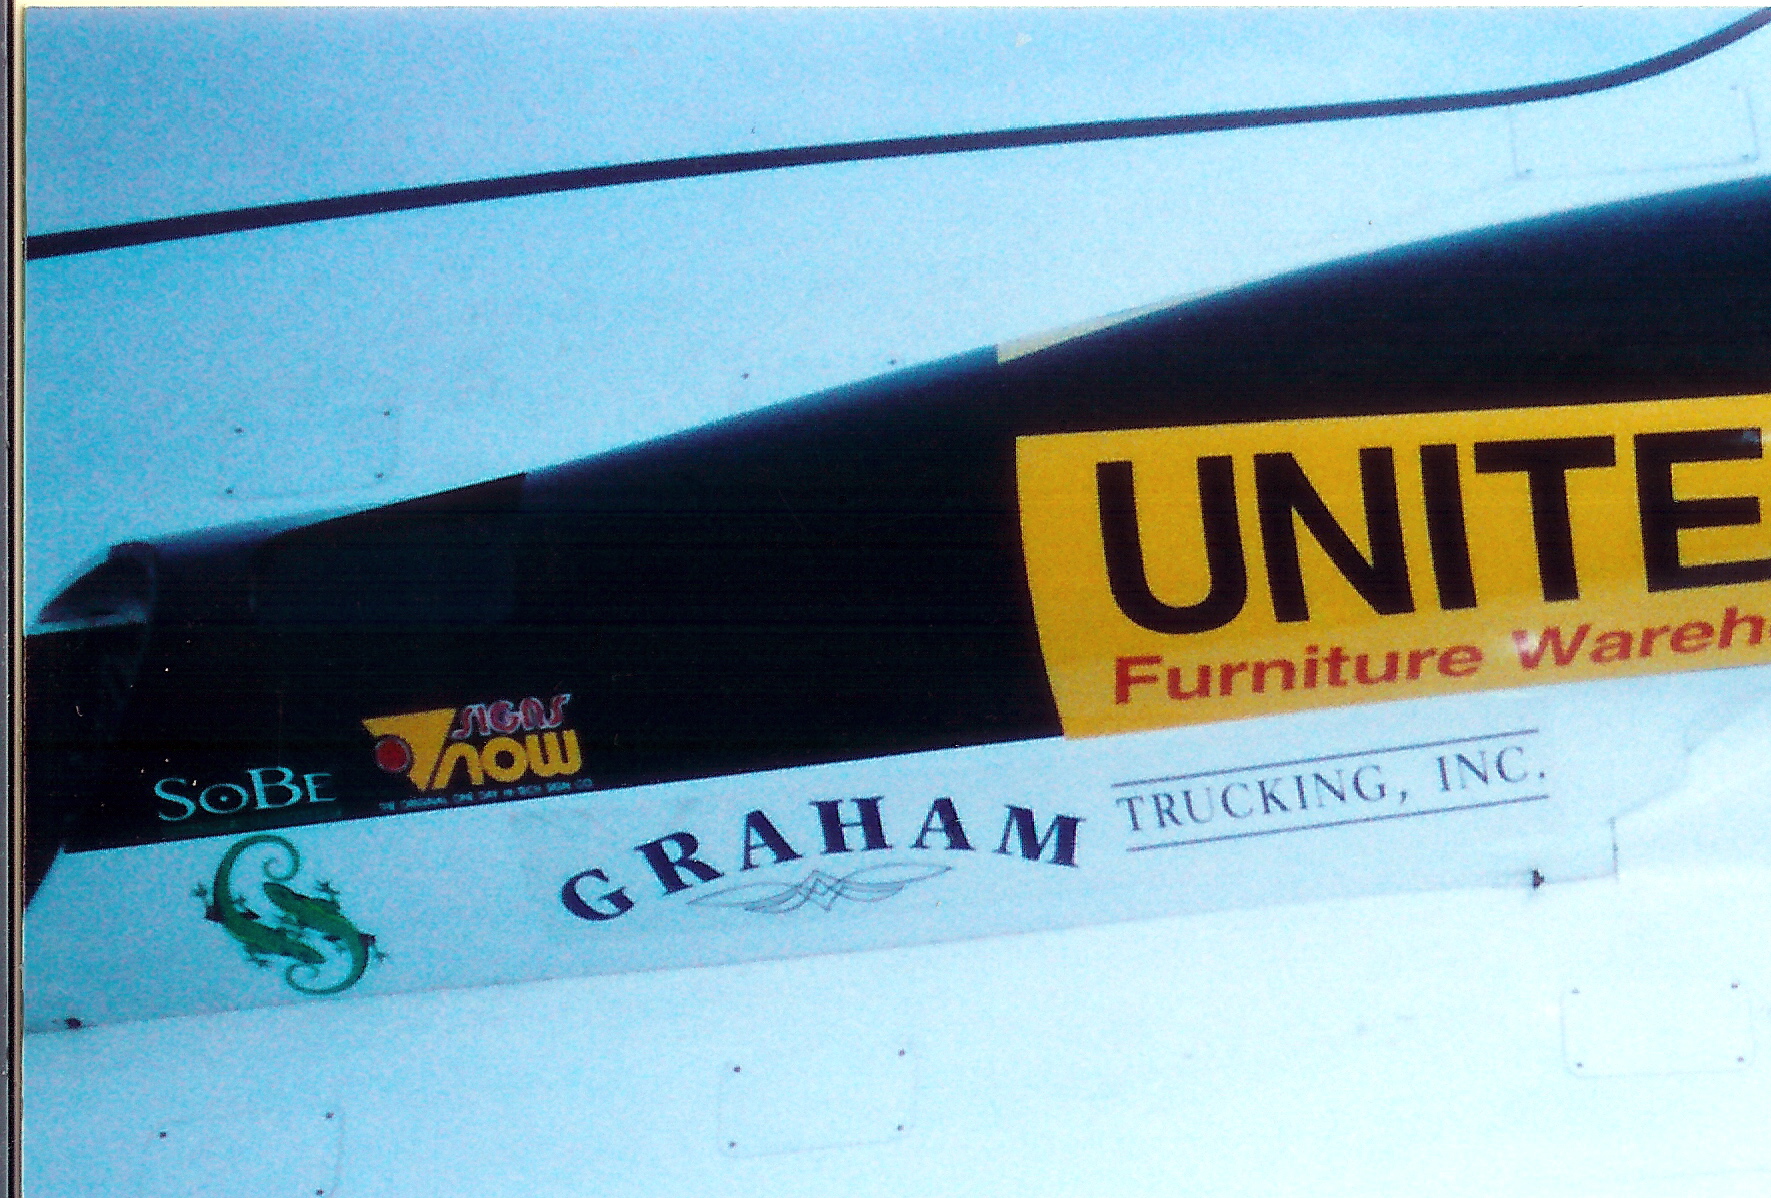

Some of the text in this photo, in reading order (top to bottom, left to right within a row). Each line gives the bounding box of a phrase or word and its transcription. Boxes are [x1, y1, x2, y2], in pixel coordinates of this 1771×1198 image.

[1114, 641, 1484, 706] Furniture
[1114, 745, 1547, 834] TRUCKING, INC.
[561, 795, 1087, 922] GRAHAM
